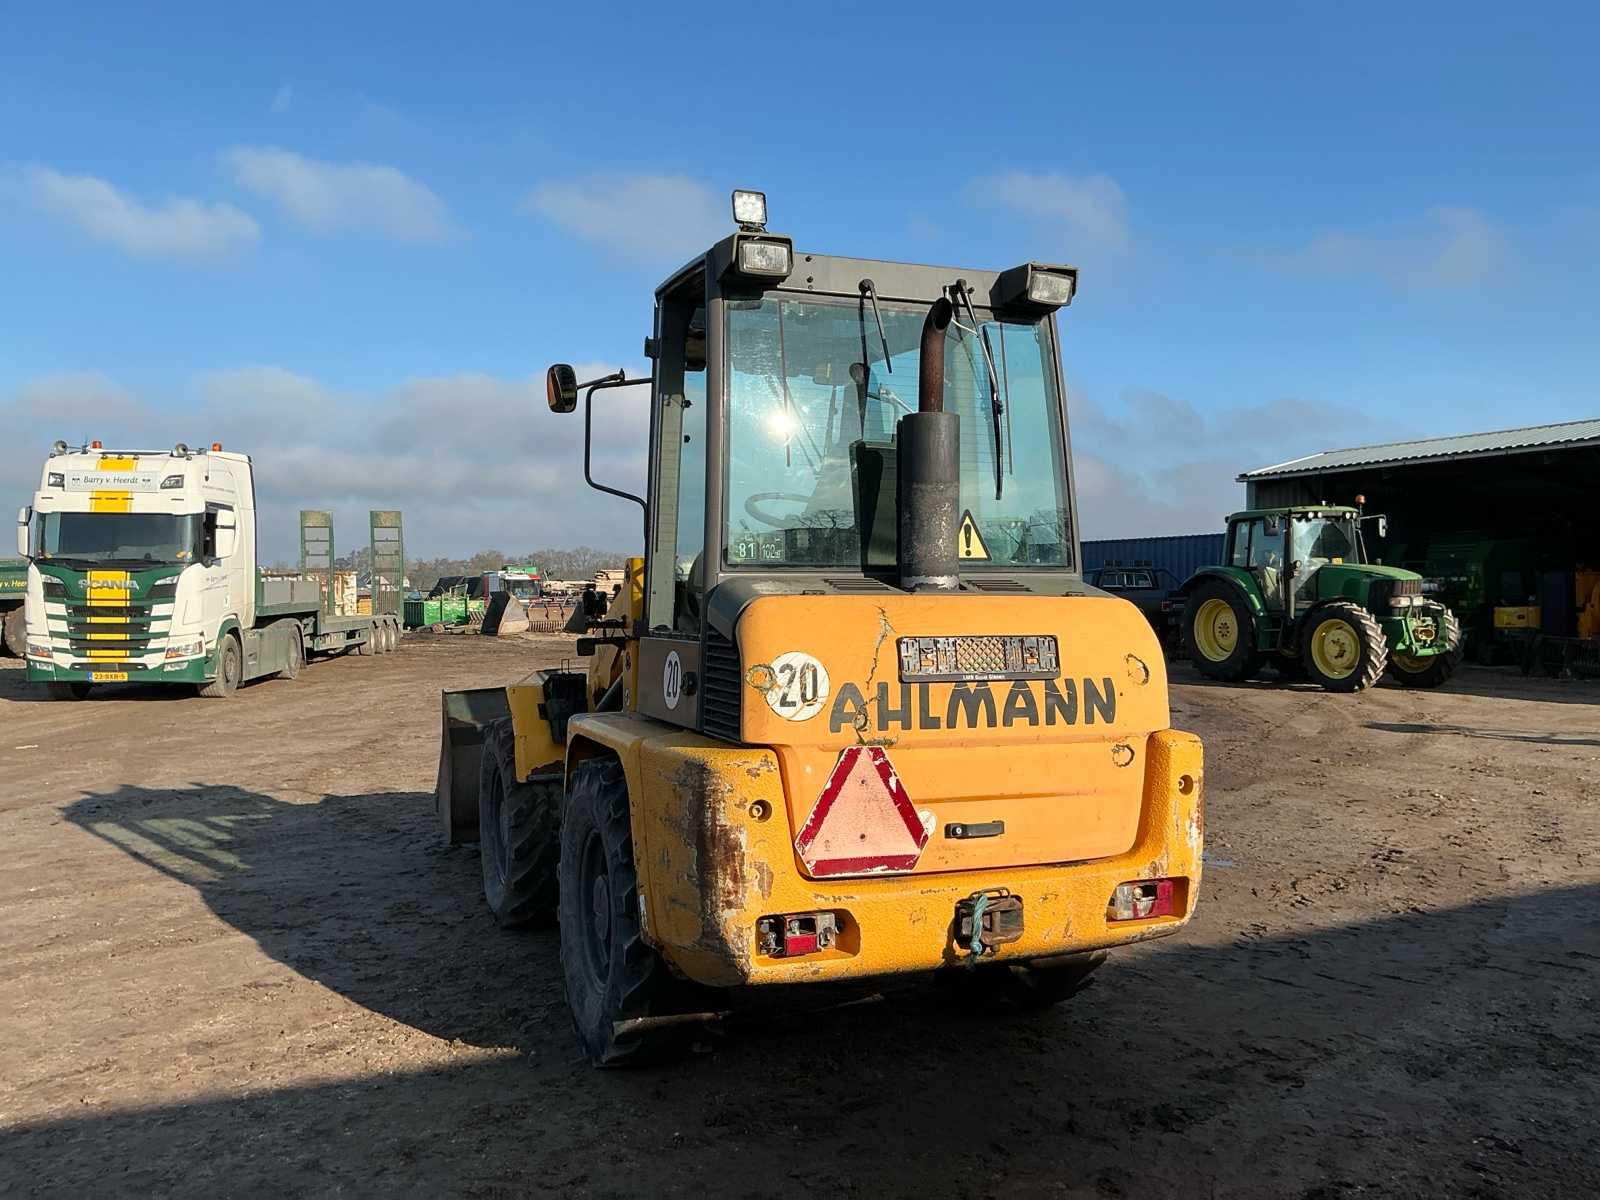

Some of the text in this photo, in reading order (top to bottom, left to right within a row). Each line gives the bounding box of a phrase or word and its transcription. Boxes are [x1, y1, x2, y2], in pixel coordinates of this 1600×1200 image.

[83, 476, 103, 484] Barry
[78, 579, 139, 591] SCANIA
[667, 659, 678, 699] 20
[778, 662, 818, 708] 20
[829, 678, 1117, 733] AHLMANN
